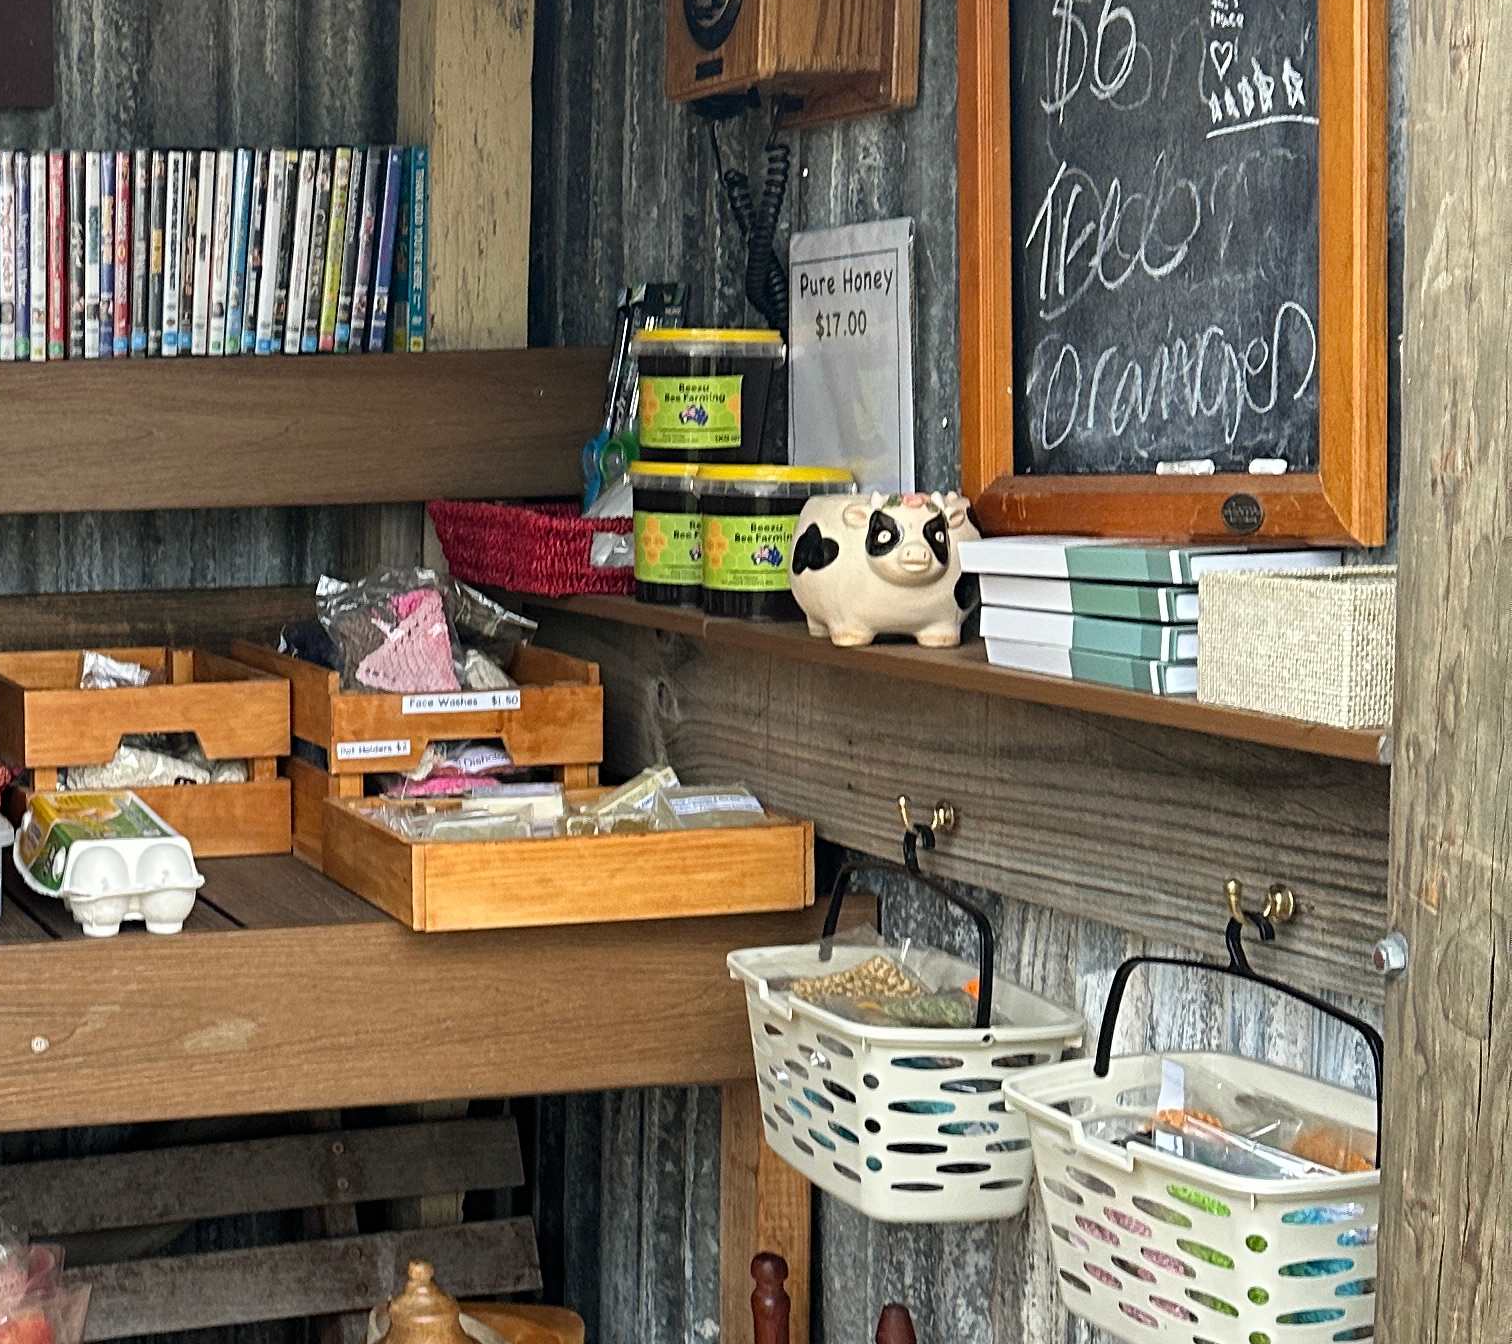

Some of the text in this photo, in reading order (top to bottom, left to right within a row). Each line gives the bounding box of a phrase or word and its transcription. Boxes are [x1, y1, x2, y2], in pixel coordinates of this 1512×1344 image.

[799, 265, 894, 298] Pure Honey
[815, 309, 867, 341] $17.00
[683, 394, 726, 404] Farming
[755, 533, 793, 544] Farmin
[409, 698, 434, 709] Face
[438, 695, 478, 708] Washes
